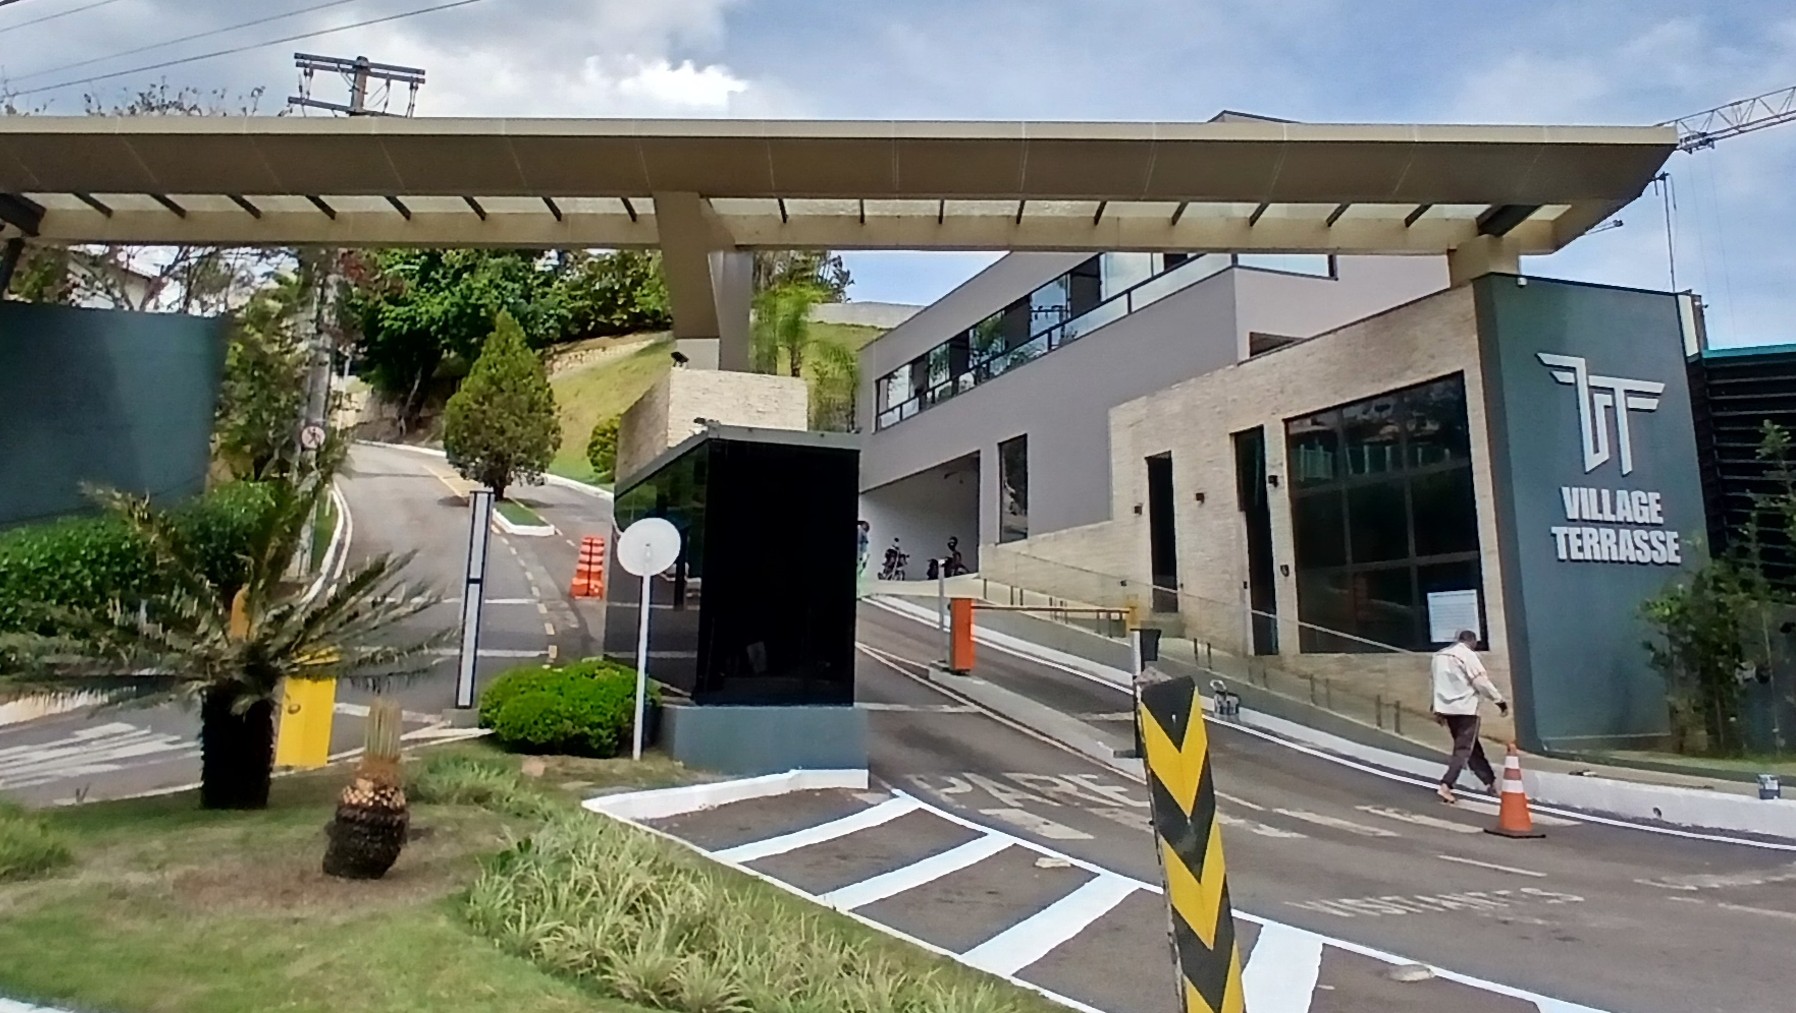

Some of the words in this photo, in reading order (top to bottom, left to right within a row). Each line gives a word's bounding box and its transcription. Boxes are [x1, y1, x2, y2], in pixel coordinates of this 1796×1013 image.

[1561, 486, 1664, 524] VILLAGE
[1551, 526, 1682, 564] TERRASSE
[904, 772, 1151, 808] PARE
